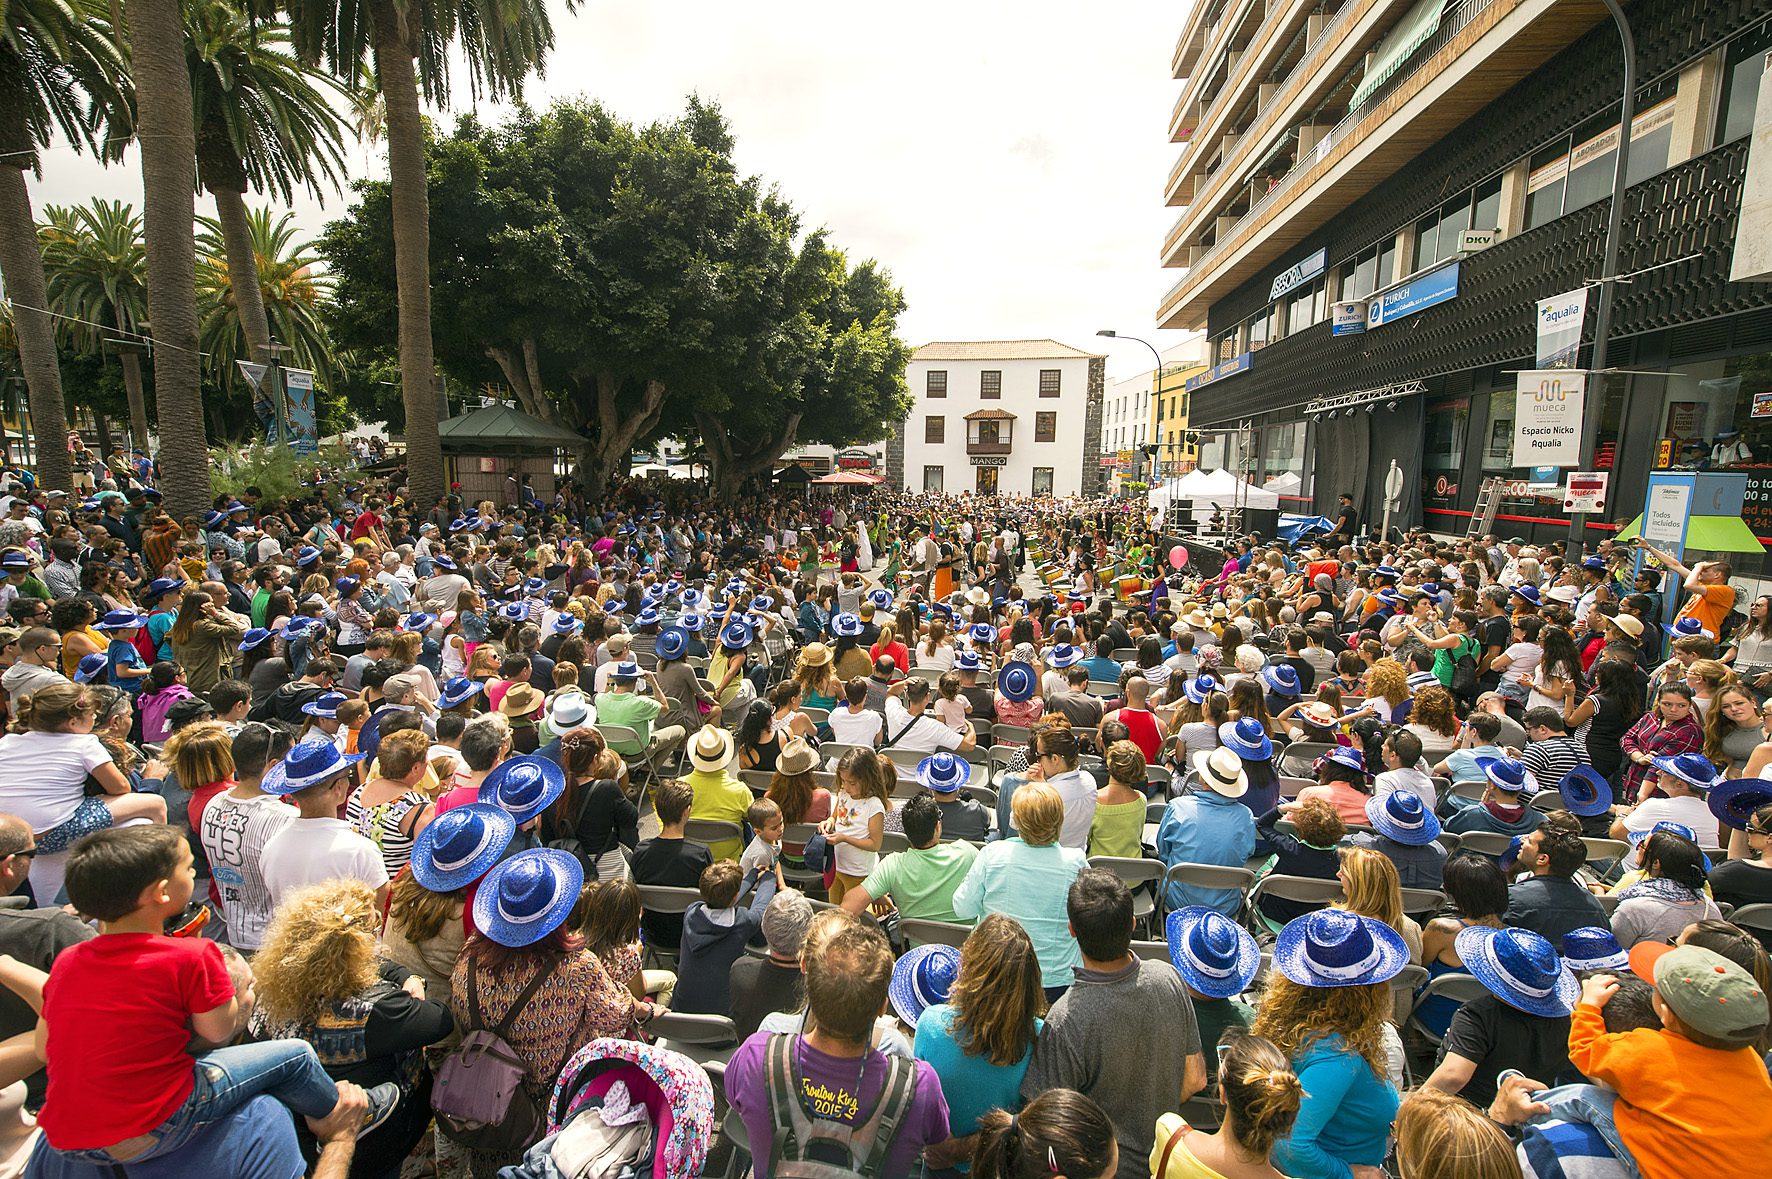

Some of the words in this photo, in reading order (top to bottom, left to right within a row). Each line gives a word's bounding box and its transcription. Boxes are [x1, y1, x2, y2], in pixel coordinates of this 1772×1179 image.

[1575, 132, 1616, 159] ABOGADOS
[1466, 236, 1491, 244] DKV
[1384, 287, 1410, 307] ZURICH
[1338, 314, 1362, 322] ZURICH
[1545, 303, 1579, 322] aqualia
[1533, 403, 1566, 412] mueca
[1521, 426, 1551, 437] Espacio
[1553, 426, 1575, 435] Nicko
[1531, 439, 1562, 449] Aqualia
[970, 457, 1006, 465] MANGO
[1652, 511, 1671, 519] Todos
[1651, 518, 1681, 528] incluidos
[205, 805, 249, 835] BLOCK
[203, 823, 243, 867] 43
[837, 1087, 859, 1116] King
[814, 1099, 842, 1118] 2015
